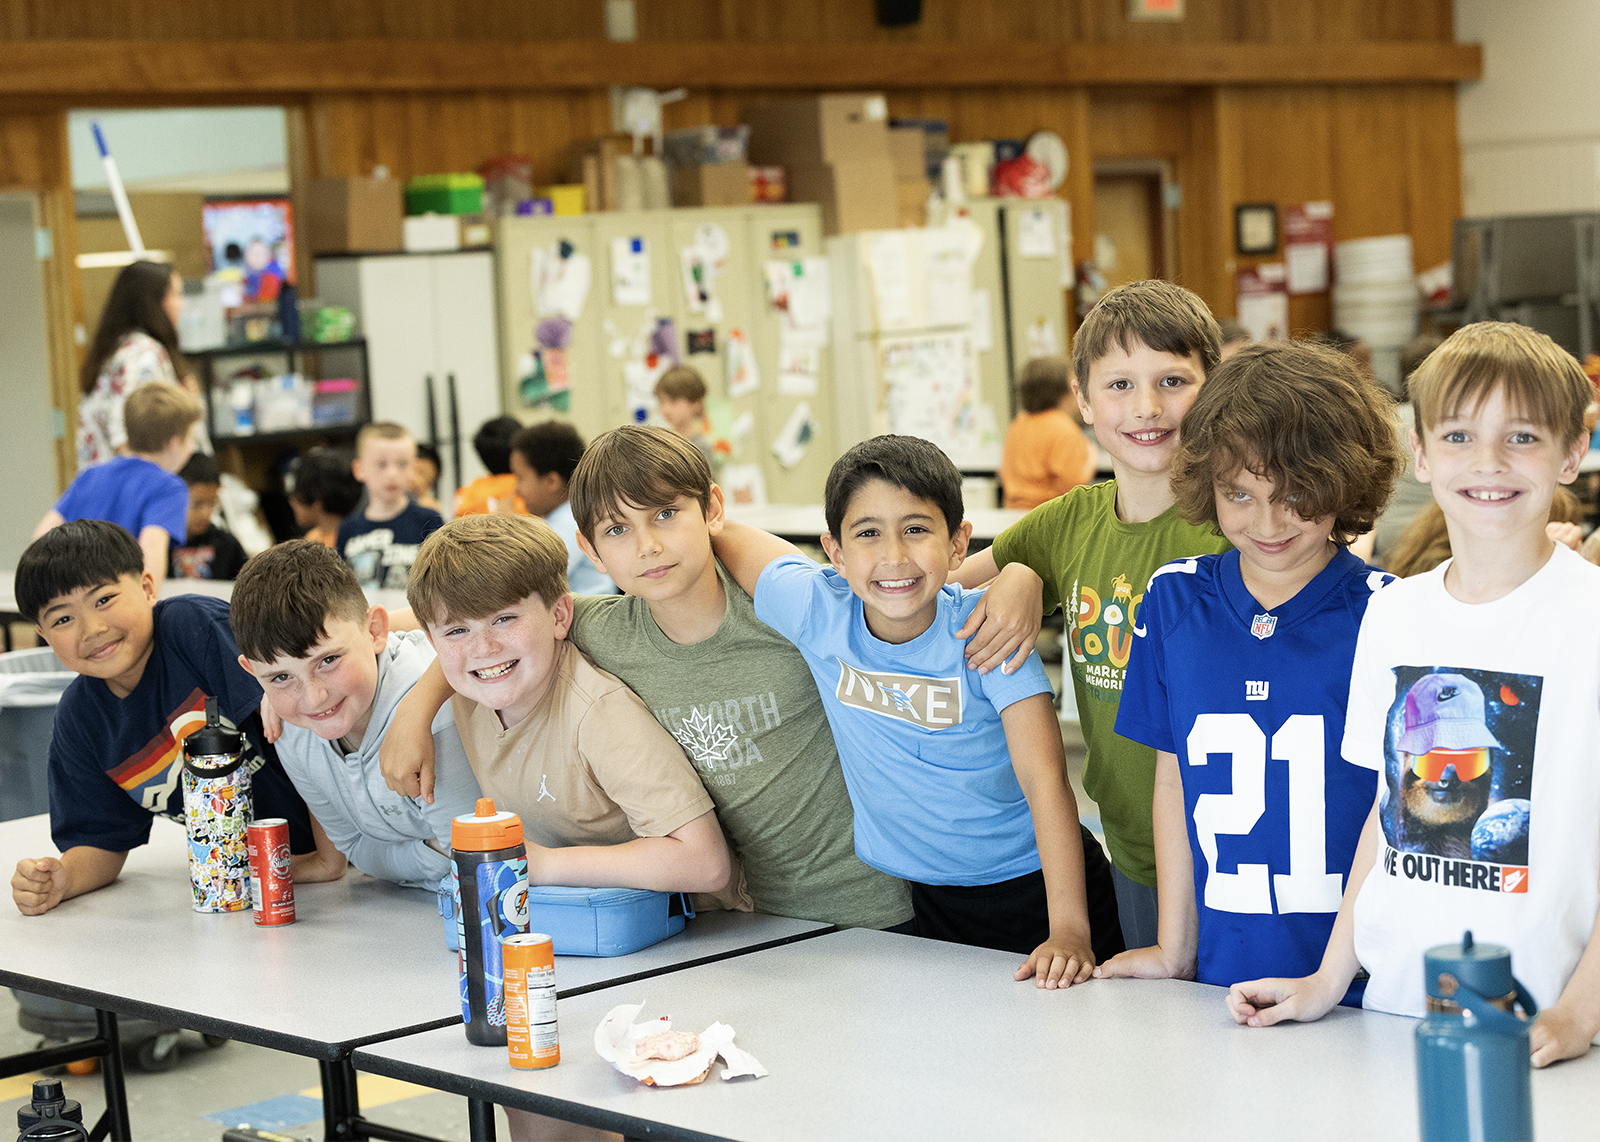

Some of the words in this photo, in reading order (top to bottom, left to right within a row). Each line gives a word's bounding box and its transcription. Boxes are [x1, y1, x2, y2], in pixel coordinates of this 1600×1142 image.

[1254, 623, 1271, 635] NFL
[845, 666, 953, 724] NIKE
[1086, 665, 1119, 679] MARK
[1186, 713, 1343, 915] 21
[1383, 846, 1398, 877] WE
[1402, 854, 1440, 883] OUT
[1443, 860, 1500, 892] HERE
